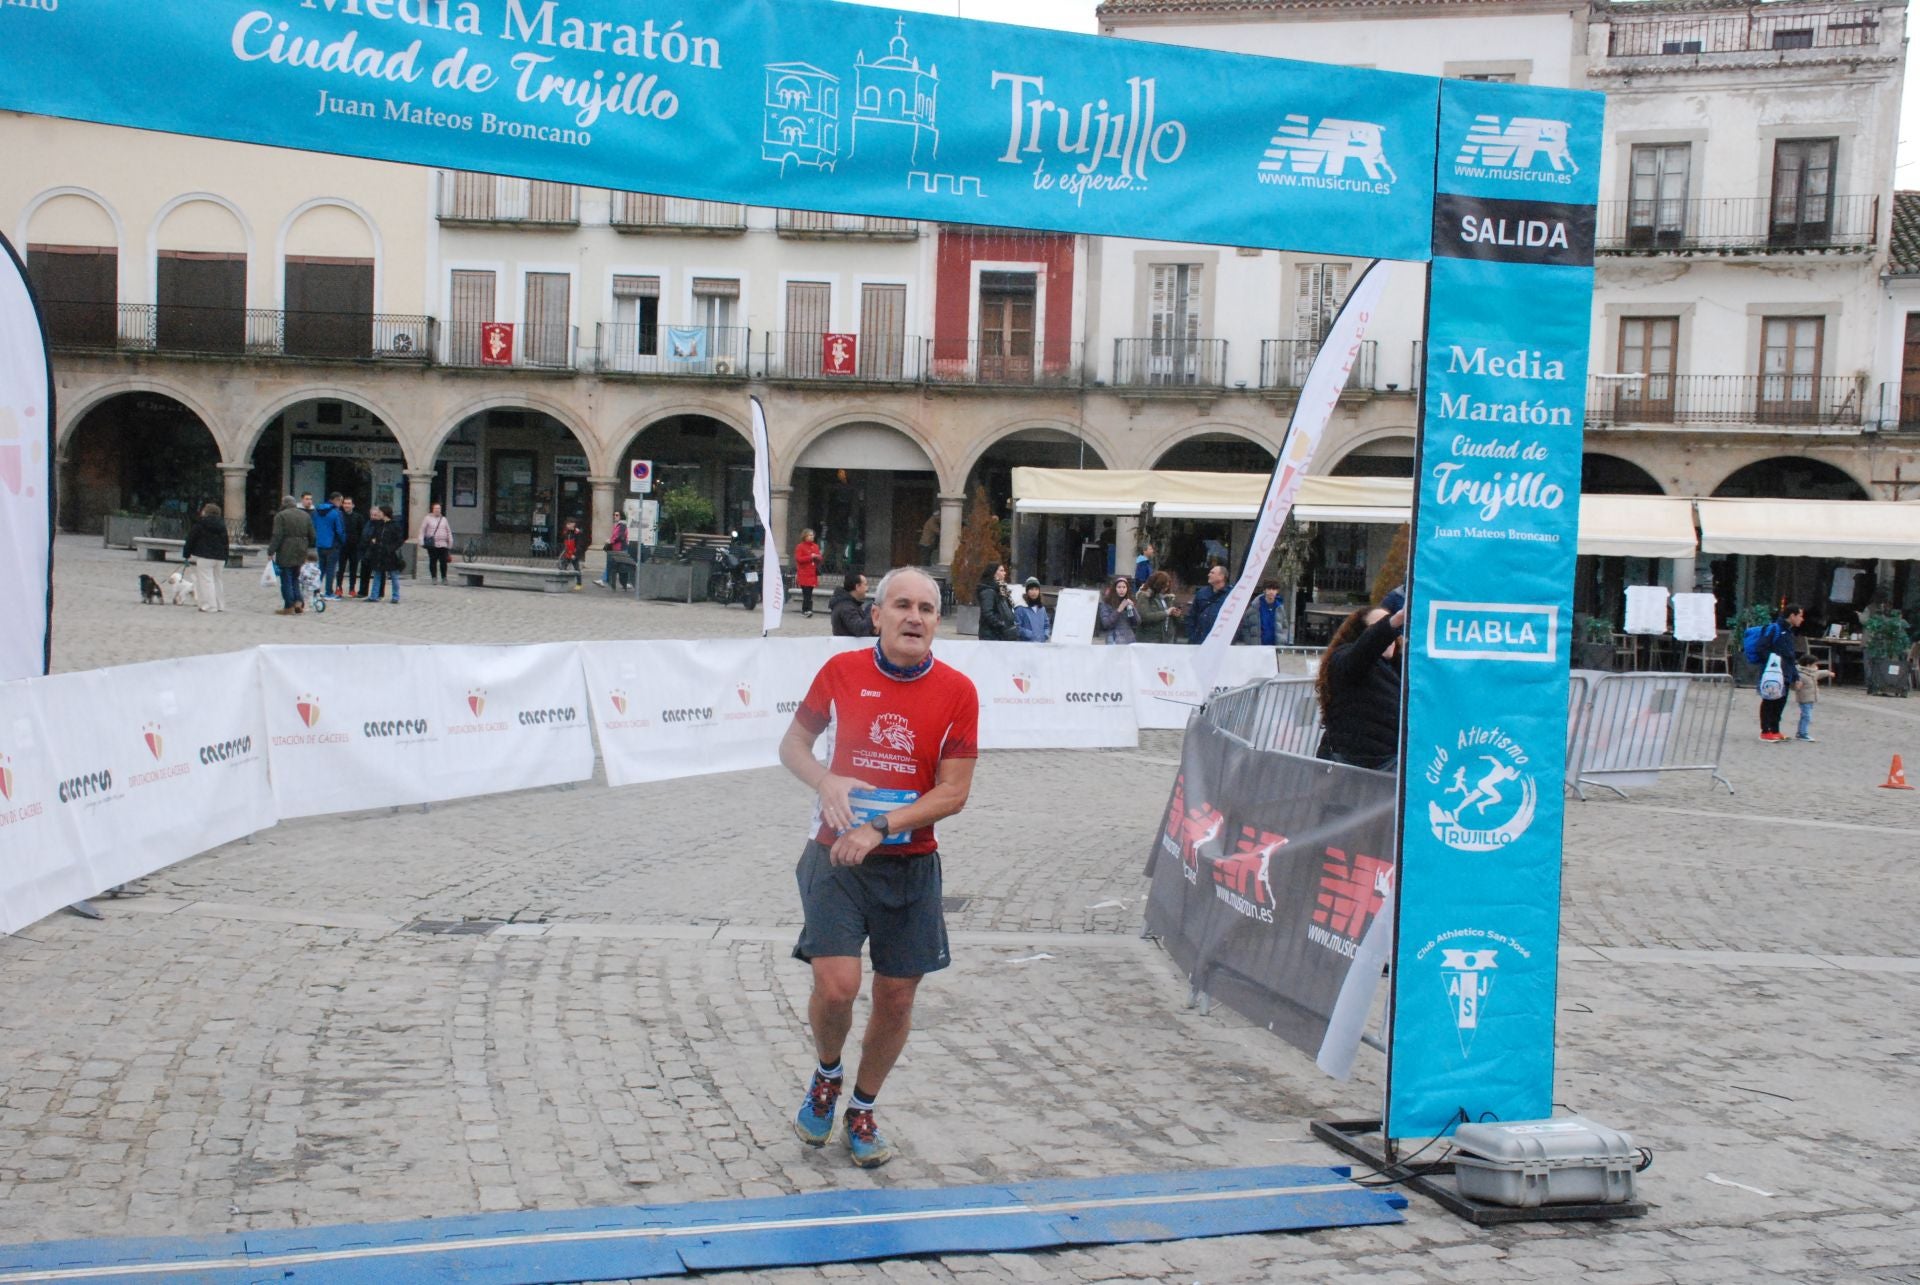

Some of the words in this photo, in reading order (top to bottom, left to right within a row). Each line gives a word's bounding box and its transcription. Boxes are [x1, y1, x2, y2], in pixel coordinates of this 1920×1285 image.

[300, 0, 481, 35] edia
[500, 0, 723, 70] Maratón
[231, 10, 424, 83] Ciudad
[431, 39, 500, 93] de
[510, 52, 679, 127] Trujillo
[316, 89, 376, 118] Juan
[383, 98, 473, 131] Mateos
[481, 112, 591, 146] Broncano
[990, 69, 1187, 181] Trujillo
[1033, 157, 1056, 190] te
[1059, 173, 1147, 208] espera...
[1257, 170, 1391, 196] www.musicrun.es
[1454, 165, 1572, 185] www.musicrun.es
[1460, 214, 1569, 249] SALIDA
[1447, 345, 1565, 381] Media
[1437, 392, 1573, 426] Maratón
[1451, 434, 1520, 459] Ciudad
[1521, 441, 1549, 460] de
[1432, 462, 1565, 521] Trujillo
[1434, 526, 1461, 539] Juan
[1464, 527, 1506, 540] Mateos
[1508, 528, 1560, 543] Broncano
[1445, 618, 1538, 645] HABLA
[860, 749, 878, 758] CLUB
[878, 752, 912, 763] MARATON
[1426, 744, 1449, 785] Club
[1458, 725, 1529, 765] Atletismo
[1416, 940, 1436, 960] Club
[1436, 927, 1485, 944] Athletico
[1487, 930, 1507, 944] San
[1508, 938, 1531, 959] José
[1448, 976, 1460, 996] A
[1477, 976, 1487, 997] J
[1463, 997, 1473, 1017] S
